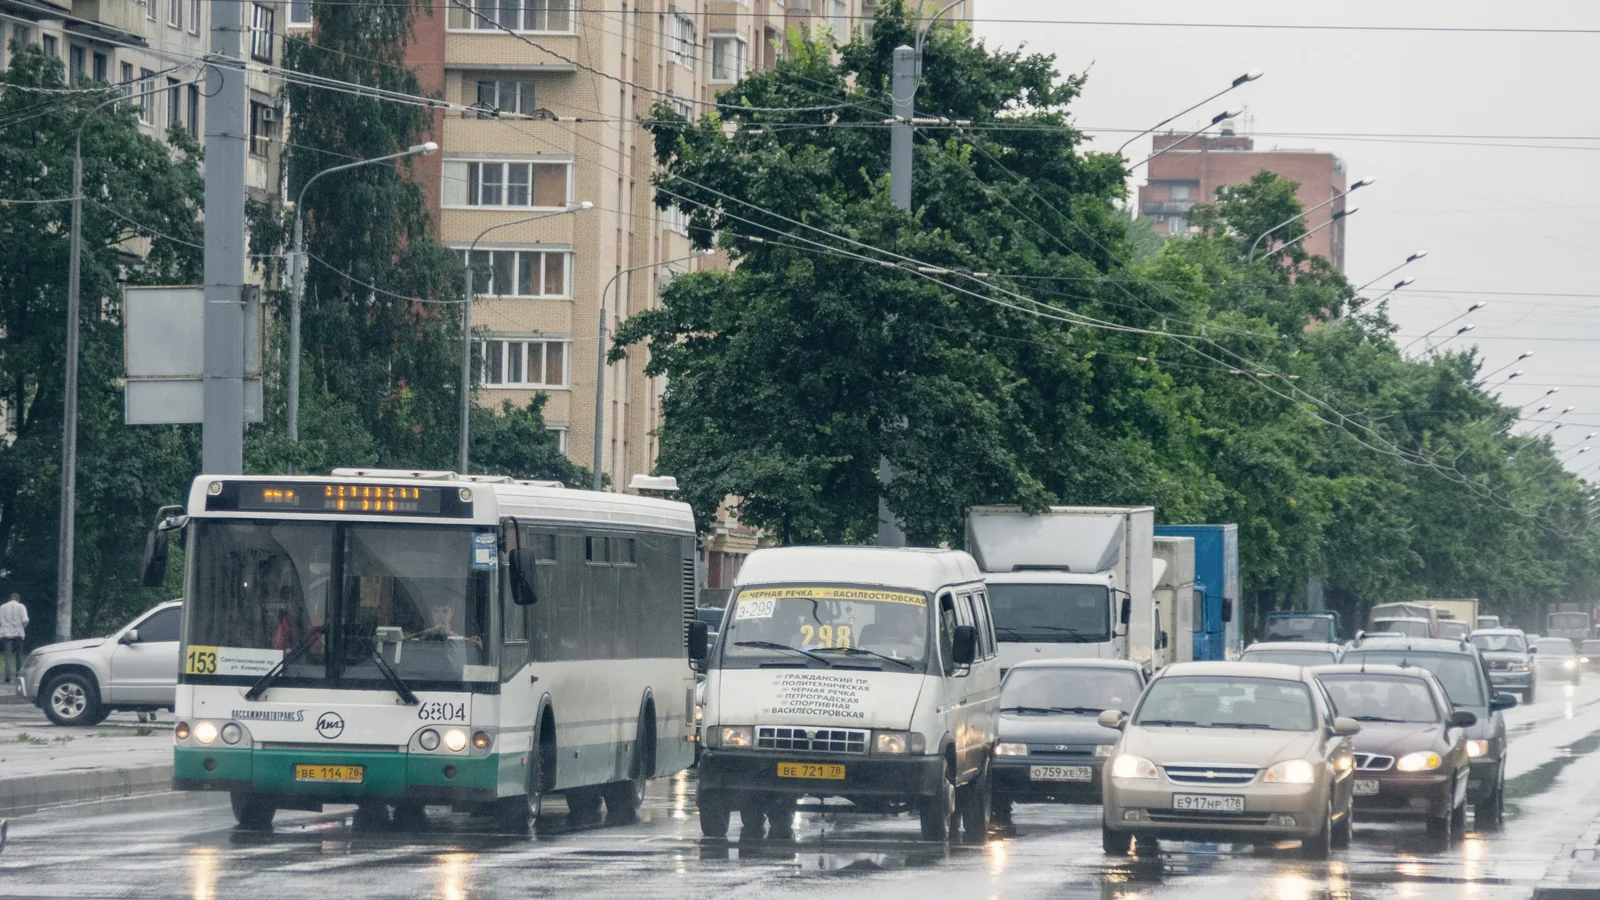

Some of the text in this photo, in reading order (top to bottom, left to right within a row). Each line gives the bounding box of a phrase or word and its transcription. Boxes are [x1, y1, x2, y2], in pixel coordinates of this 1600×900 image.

[833, 590, 927, 605] ВАСИЛЕОСТРОВСКАЯ
[800, 624, 850, 651] 298
[188, 651, 217, 674] 153
[784, 673, 853, 683] ГРАЖДАНСКИЙ
[781, 680, 870, 691] ПОЛИТЕХНИЧЕСКАЯ
[784, 693, 859, 704] ПЕТРОГРАДСКАЯ
[827, 689, 856, 697] РЕЧКА
[789, 700, 851, 710] СПОРТИВНАЯ
[418, 702, 466, 721] 6804
[771, 707, 865, 719] ВАСИЛЕОСТРОВСКАЯ
[320, 767, 342, 779] 114
[347, 767, 360, 777] 78
[802, 765, 824, 777] 721
[830, 766, 841, 775] 78
[1225, 798, 1241, 808] 178
